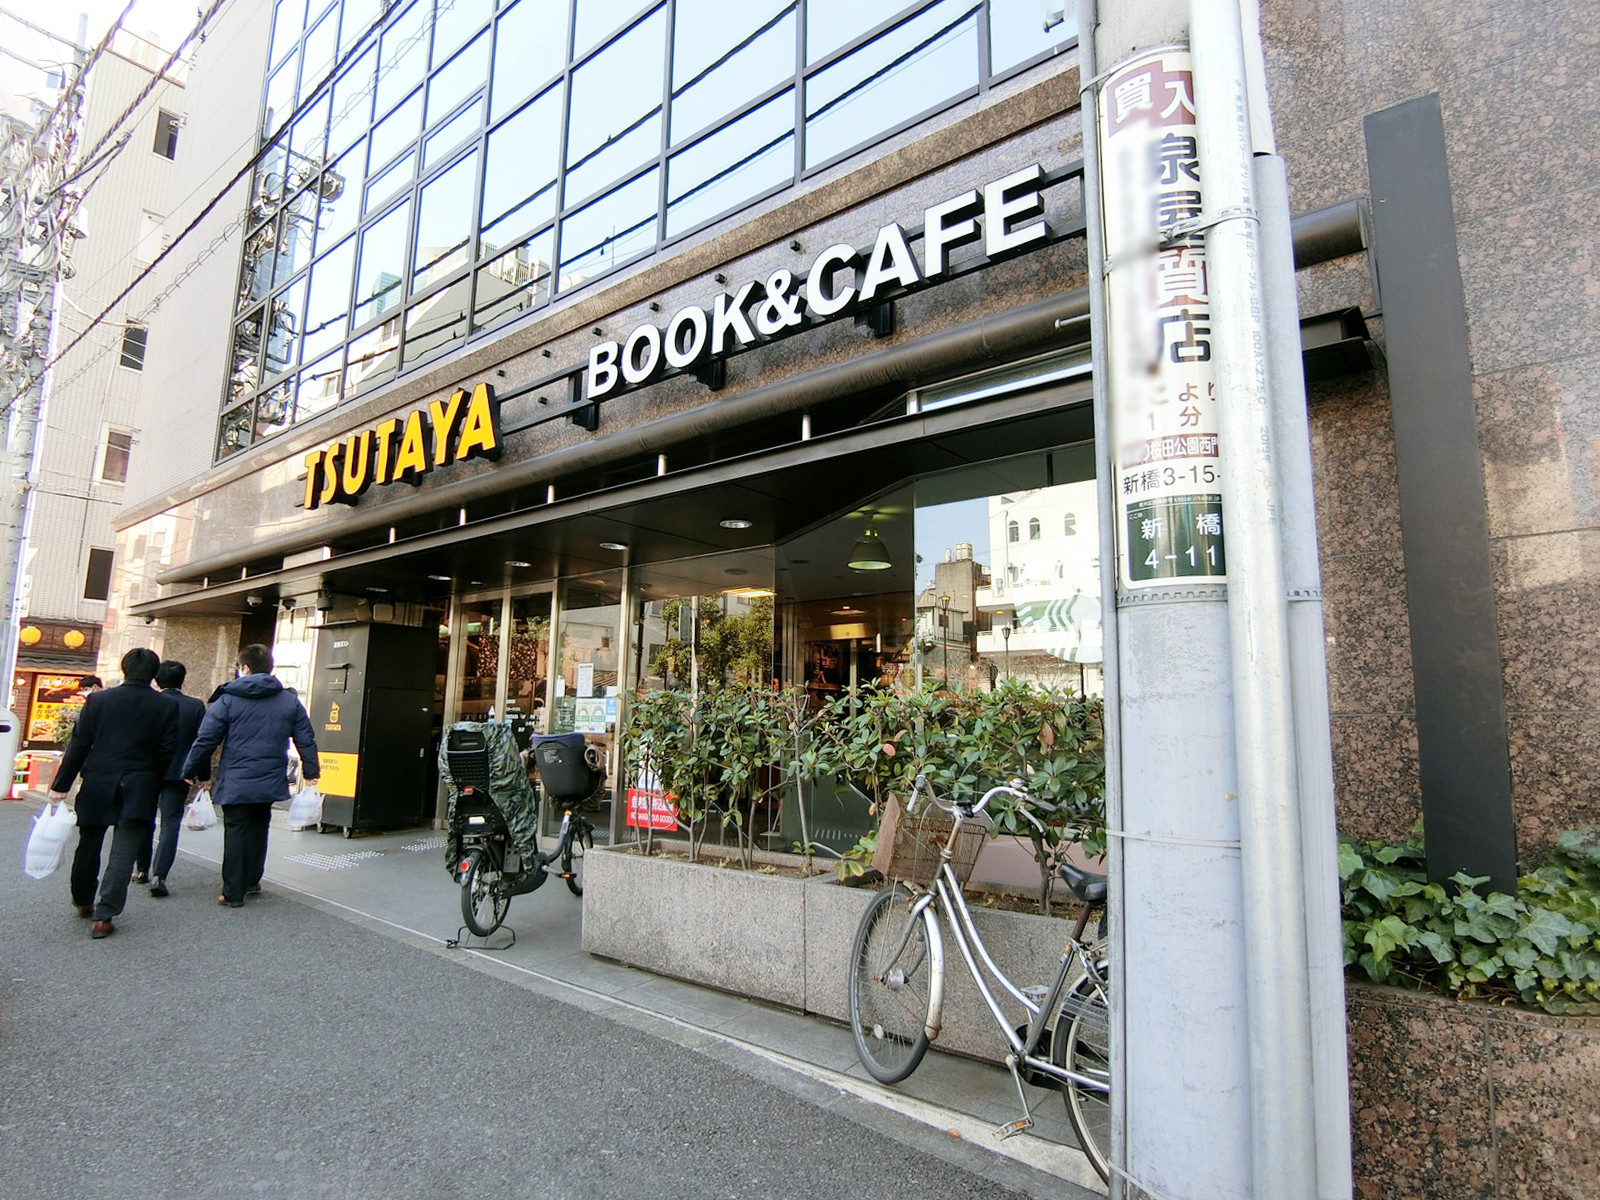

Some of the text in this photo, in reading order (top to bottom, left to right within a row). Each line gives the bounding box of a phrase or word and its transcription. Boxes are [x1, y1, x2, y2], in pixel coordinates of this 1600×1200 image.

[587, 163, 1049, 400] BOOK&CAFE
[304, 382, 498, 510] TSUTAYA
[1141, 513, 1221, 540] 新橋
[1144, 545, 1217, 569] 4-11
